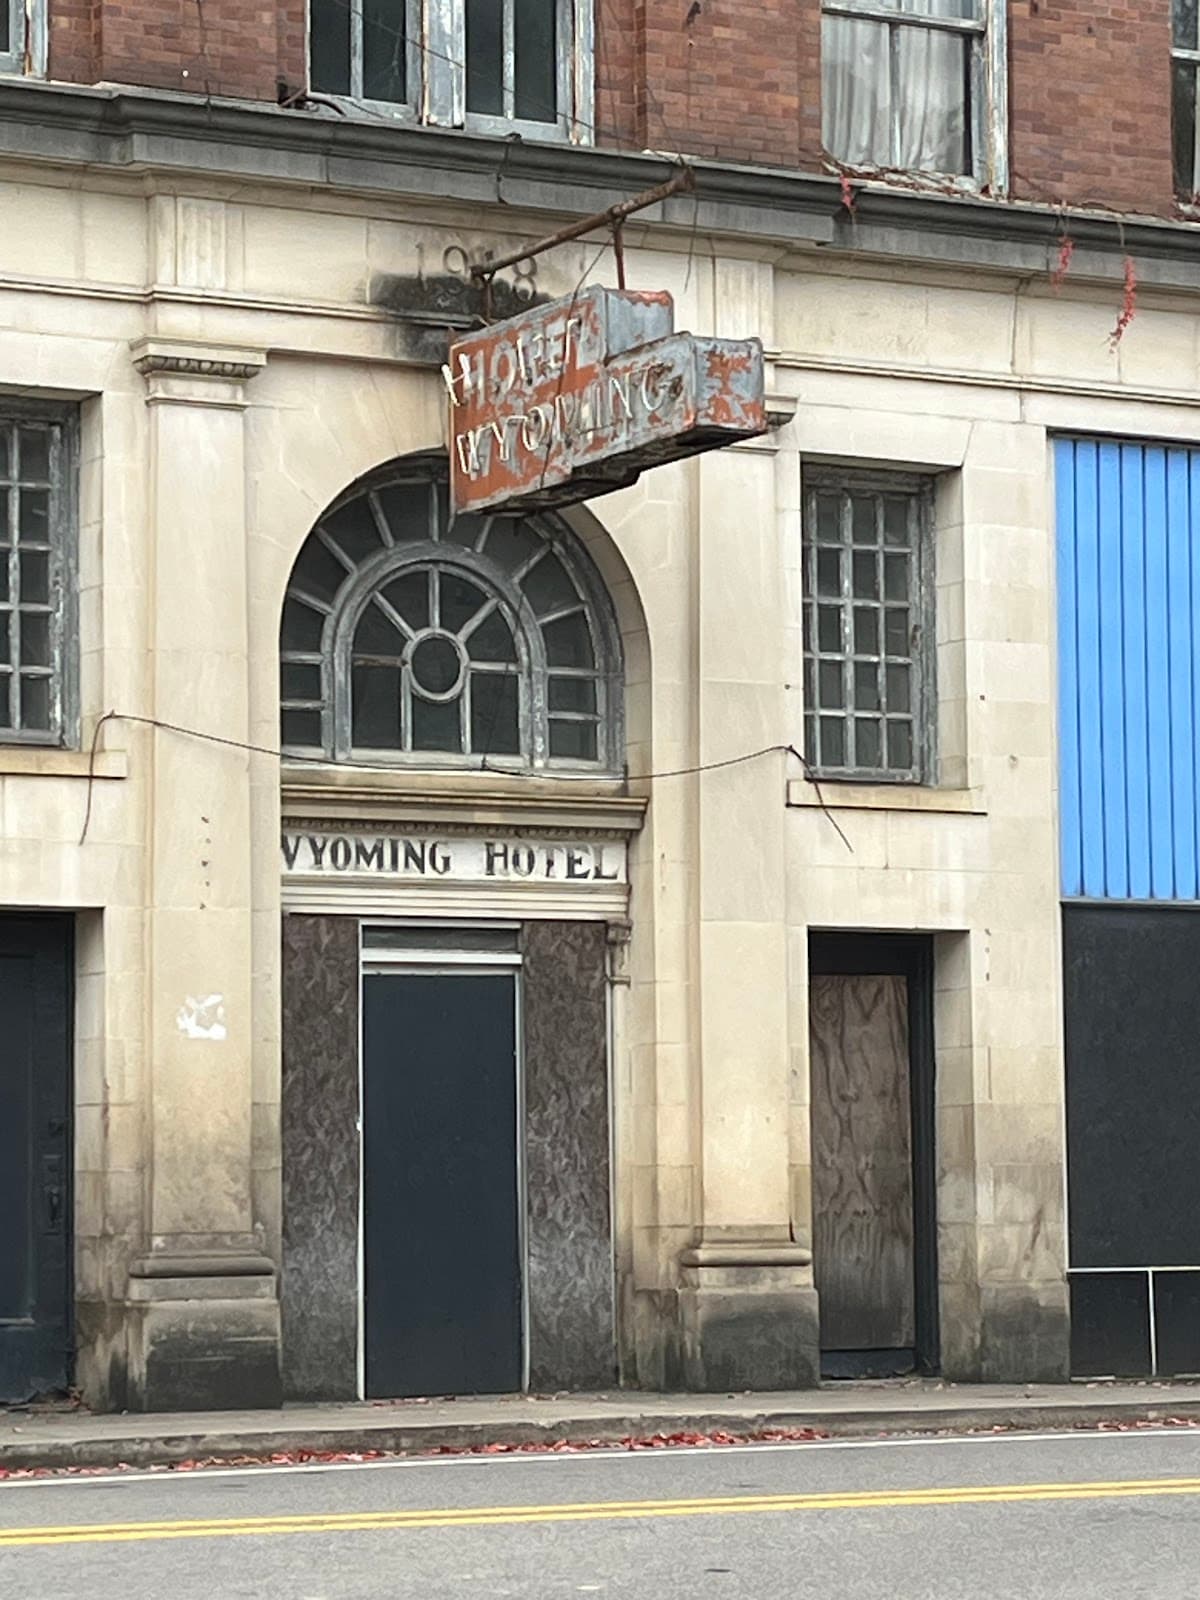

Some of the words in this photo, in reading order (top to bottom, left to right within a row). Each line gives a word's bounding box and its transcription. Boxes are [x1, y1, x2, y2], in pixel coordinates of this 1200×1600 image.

[415, 242, 538, 303] 198
[441, 306, 603, 410] HOTEL
[484, 840, 620, 880] HOTEL
